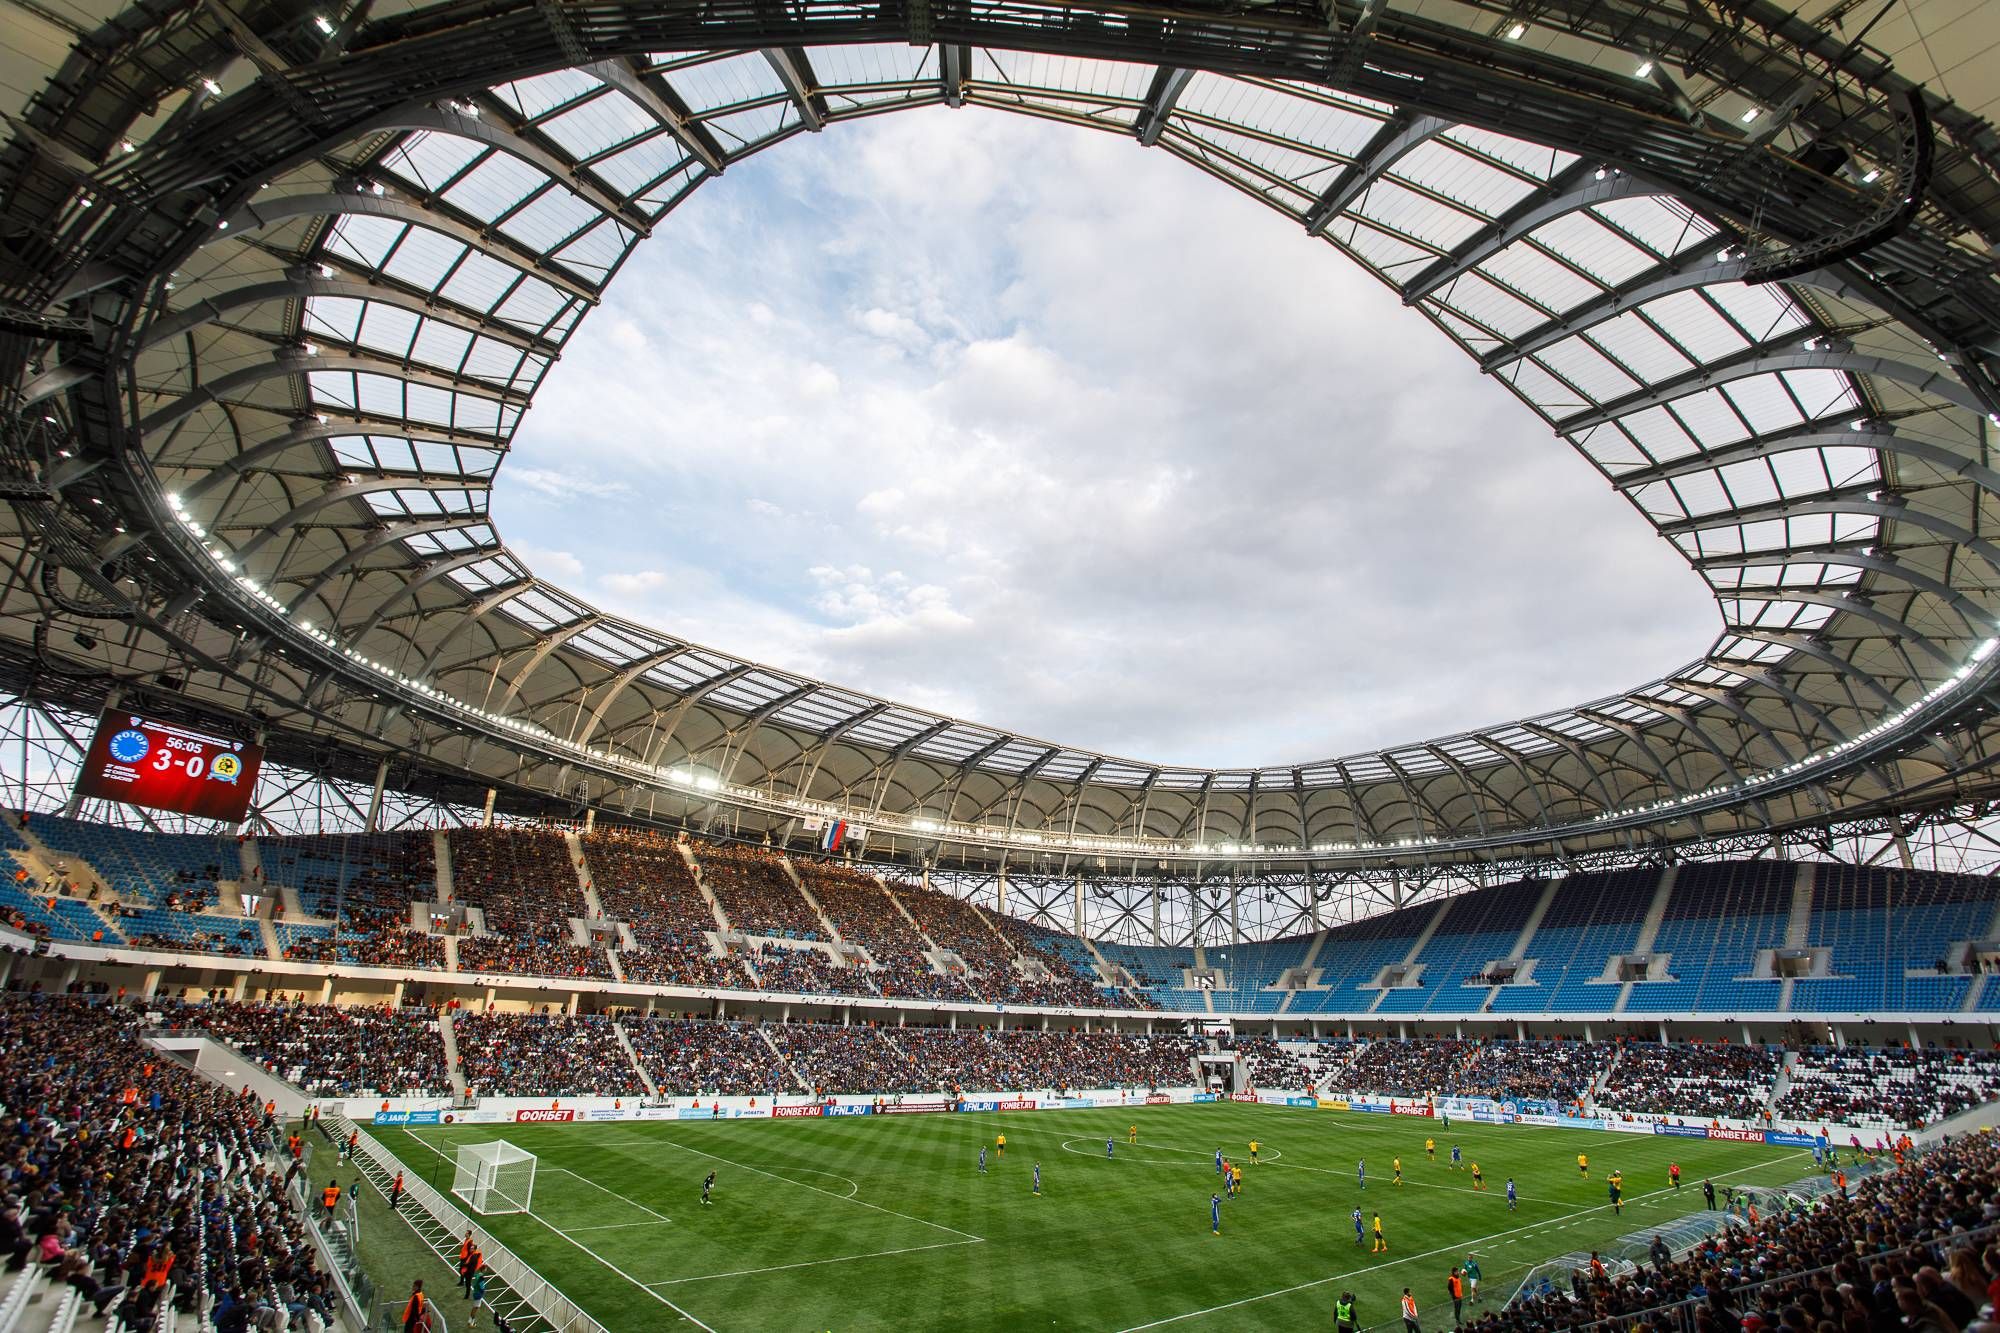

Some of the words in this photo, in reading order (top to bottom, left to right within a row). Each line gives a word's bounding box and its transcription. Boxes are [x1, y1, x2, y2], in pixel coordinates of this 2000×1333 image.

[165, 736, 203, 754] 56:05
[1146, 1096, 1170, 1104] FONBET.RU
[1231, 1094, 1256, 1102] ФОНБЕТ
[829, 1105, 865, 1115] 1FNL.RU
[964, 1101, 994, 1111] 1FNL.RU
[1000, 1100, 1033, 1110] FONBET.RU
[520, 1110, 570, 1121] ФОНБЕТ
[775, 1106, 820, 1116] FONBET.RU
[1395, 1105, 1428, 1116] ФОНБЕТ
[387, 1114, 410, 1122] JAKO
[1708, 1129, 1763, 1142] FONBET.RU
